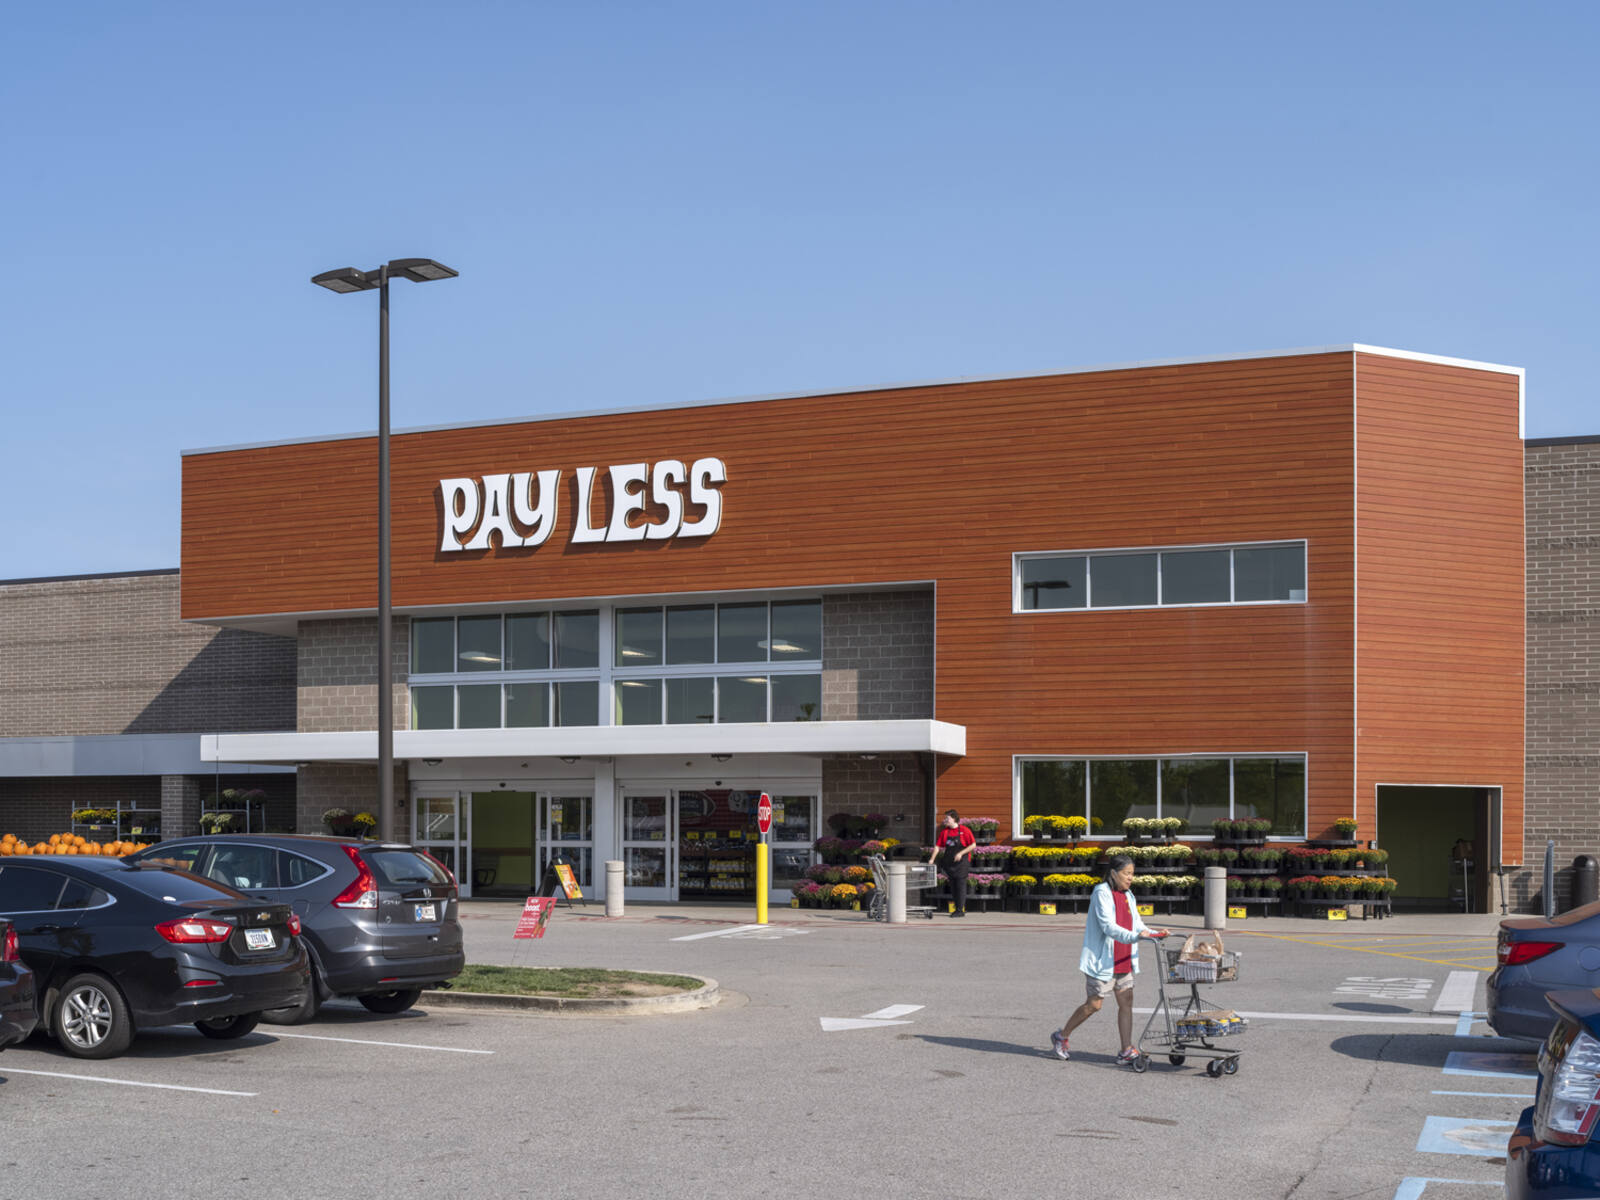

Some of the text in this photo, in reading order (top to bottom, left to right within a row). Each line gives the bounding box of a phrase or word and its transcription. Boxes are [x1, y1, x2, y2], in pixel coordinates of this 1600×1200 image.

[440, 457, 728, 552] PAY LESS
[759, 806, 771, 821] STOP
